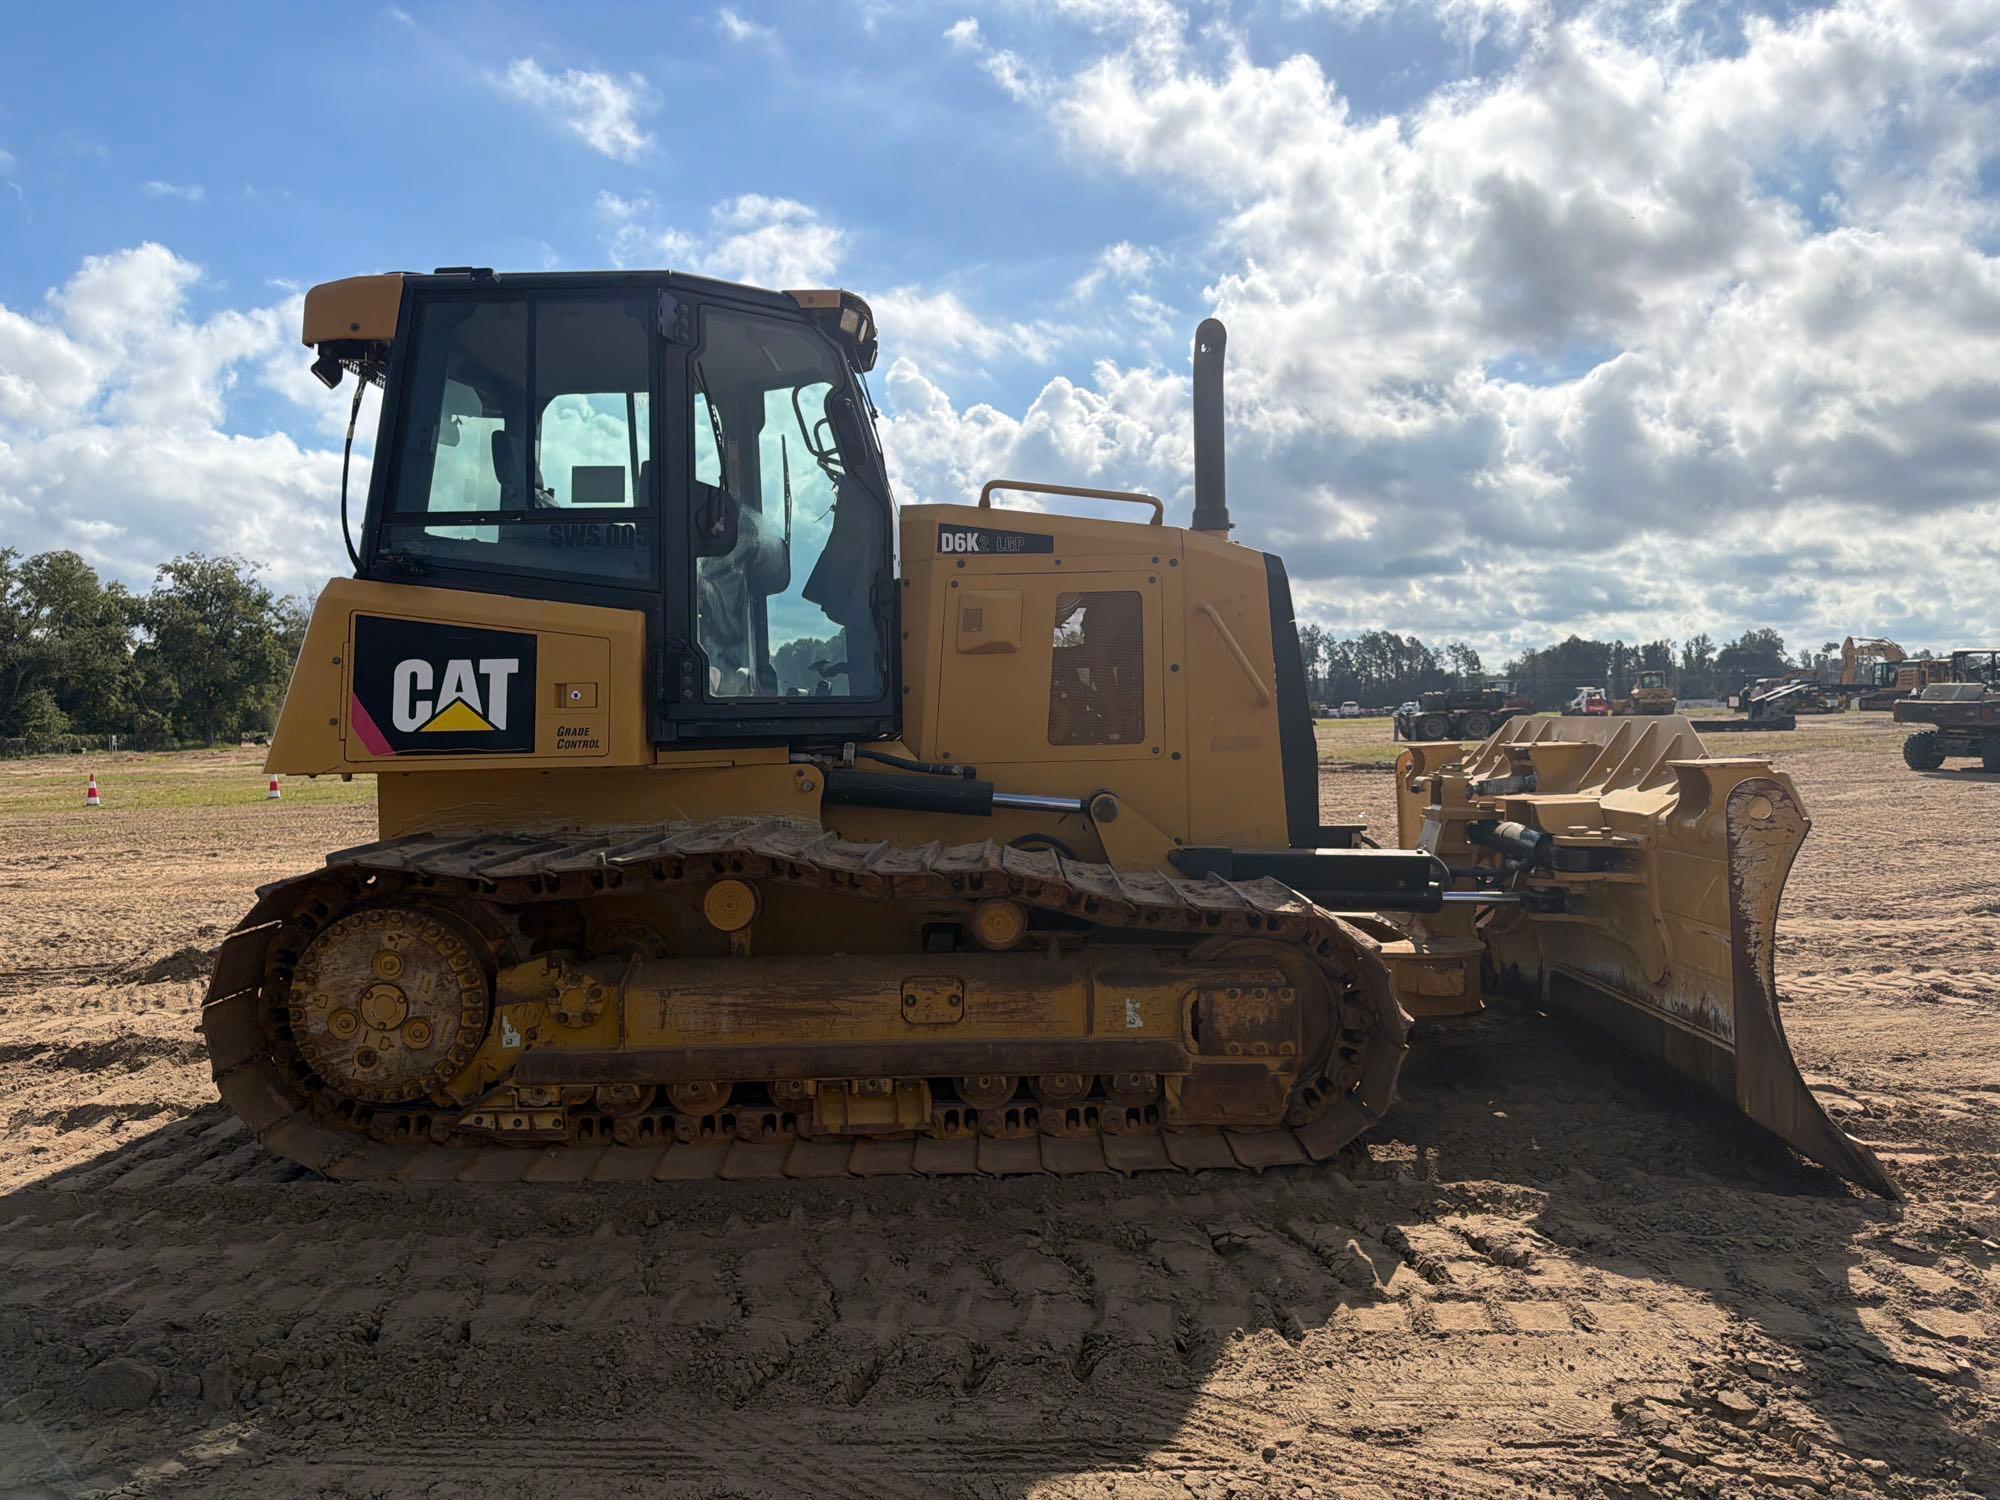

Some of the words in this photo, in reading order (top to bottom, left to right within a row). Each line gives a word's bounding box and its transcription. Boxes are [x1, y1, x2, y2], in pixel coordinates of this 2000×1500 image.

[548, 524, 601, 547] SWS
[996, 536, 1025, 552] LGP
[392, 658, 519, 732] CAT
[557, 726, 590, 737] GRADE
[557, 738, 600, 750] CONTROL
